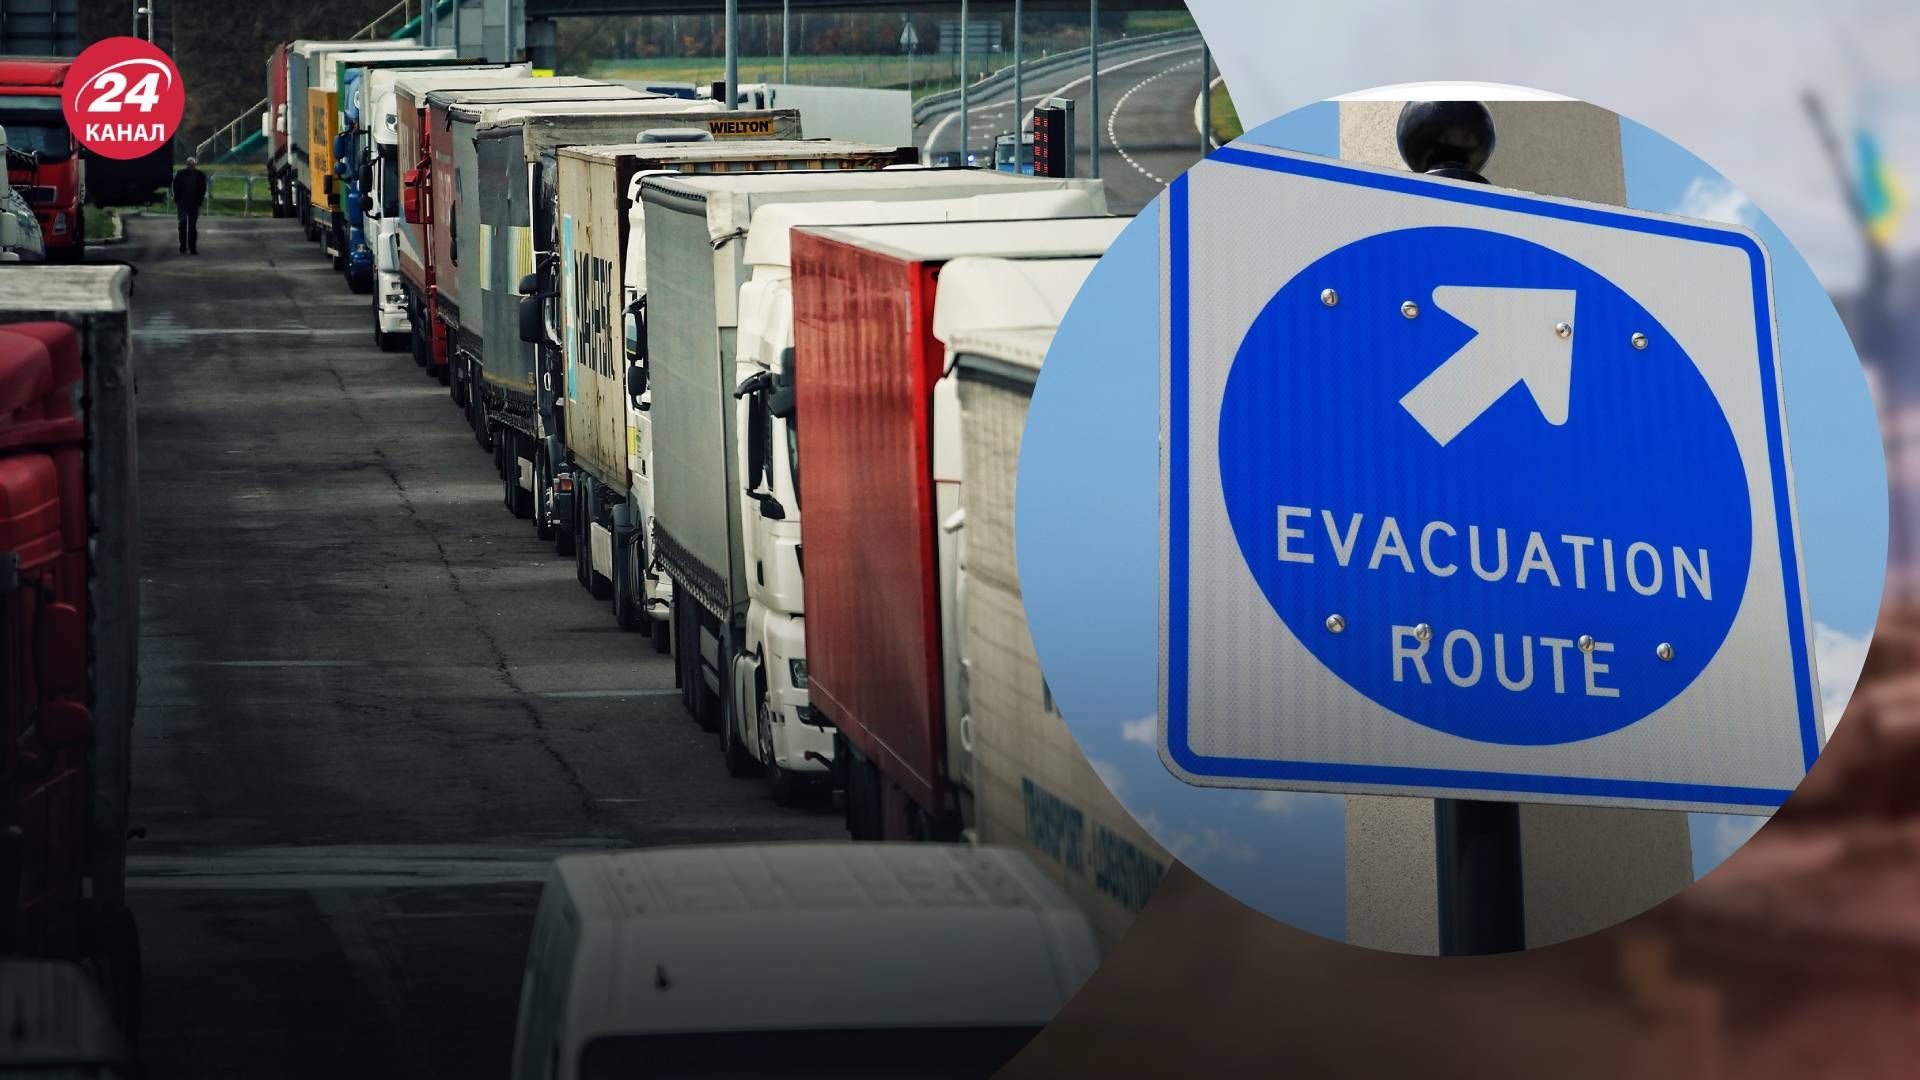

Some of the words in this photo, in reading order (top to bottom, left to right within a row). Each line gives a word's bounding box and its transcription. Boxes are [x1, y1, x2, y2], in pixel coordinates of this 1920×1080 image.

[709, 120, 769, 134] WIELTON
[1276, 504, 1713, 601] EVACUATION
[1391, 624, 1620, 698] ROUTE
